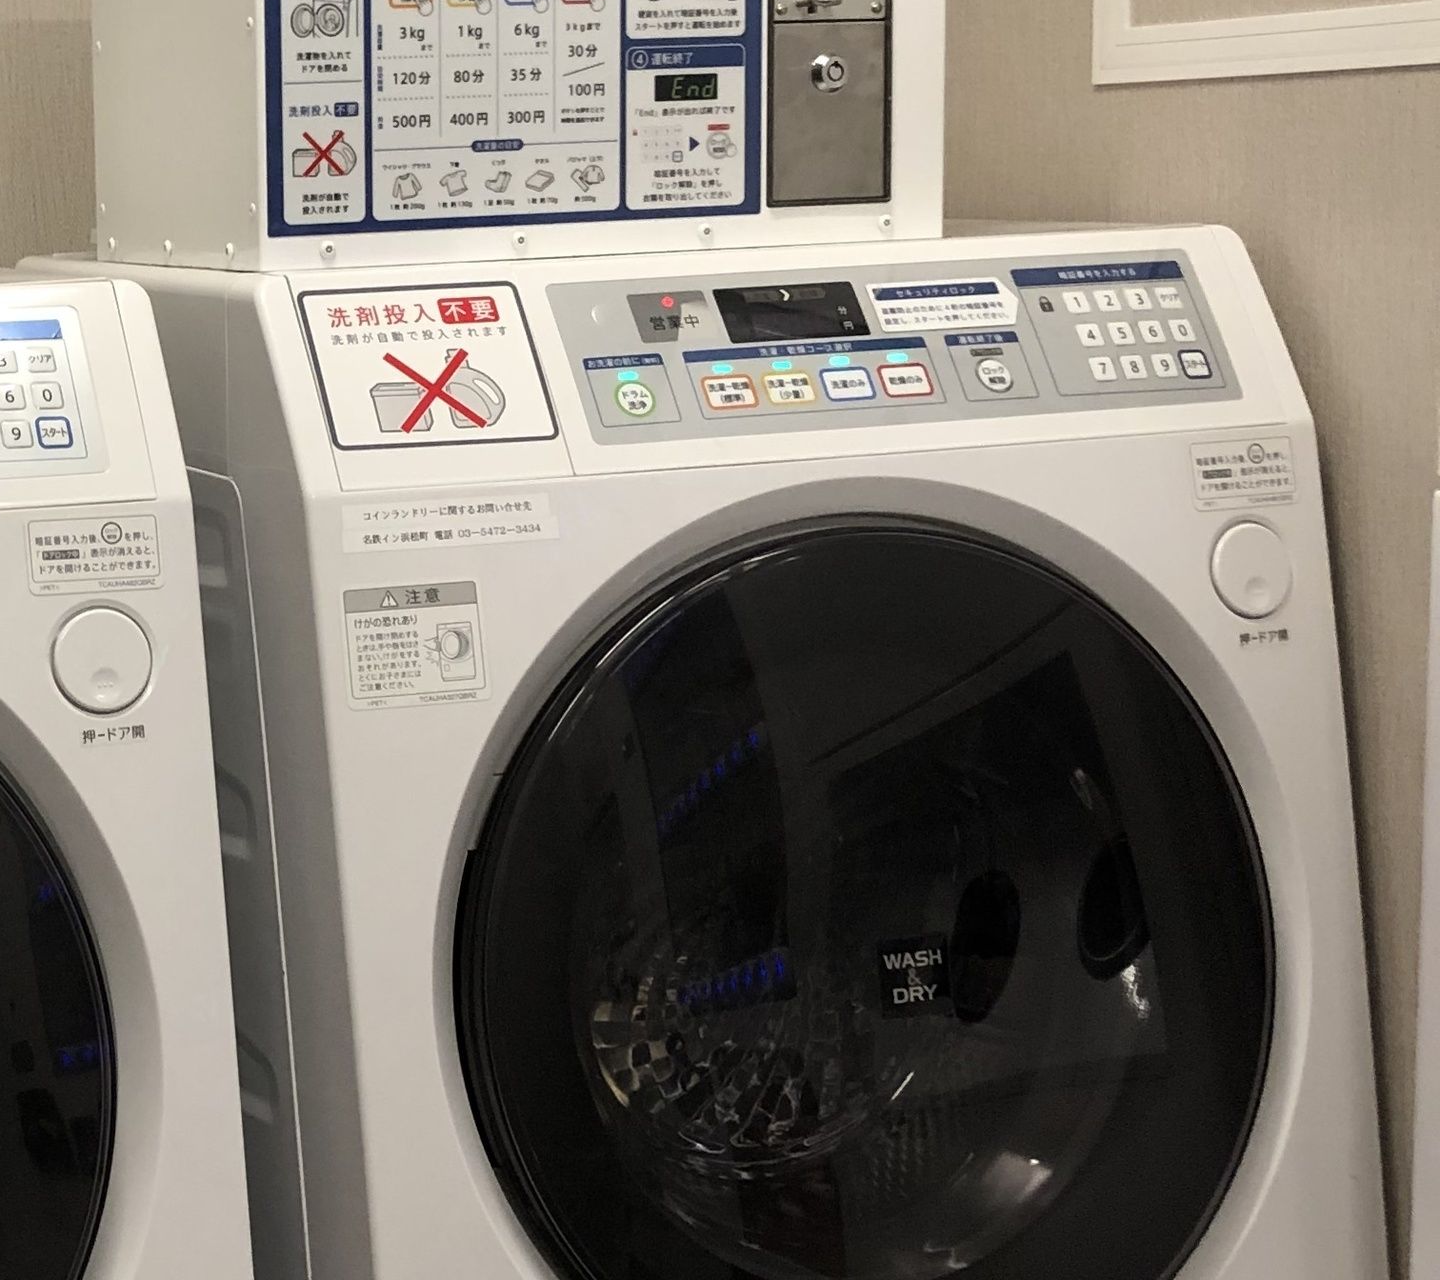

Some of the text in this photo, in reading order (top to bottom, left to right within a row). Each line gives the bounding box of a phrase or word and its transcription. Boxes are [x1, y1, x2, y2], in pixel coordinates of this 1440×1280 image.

[400, 27, 425, 41] 3kg
[458, 25, 482, 39] 1kg
[514, 24, 540, 37] 6kg
[568, 45, 597, 57] 30分
[651, 53, 693, 65] 運転終了
[393, 72, 431, 84] 120分
[454, 70, 484, 83] 80分
[511, 69, 541, 81] 35分
[569, 83, 605, 96] 100円
[672, 77, 715, 99] End
[289, 105, 357, 117] 洗剤投入 不要
[508, 111, 545, 123] 300円
[392, 115, 431, 128] 500円
[450, 112, 489, 126] 400円
[1073, 297, 1082, 308] 1
[1104, 295, 1114, 306] 2
[1135, 293, 1144, 305] 3
[327, 300, 496, 328] 洗剤投入 不要
[649, 314, 700, 331] 営業中
[331, 326, 507, 345] 洗剤が自動で投入されます
[1087, 329, 1096, 341] 4
[1118, 328, 1127, 339] 5
[1149, 326, 1158, 337] 6
[1178, 325, 1187, 336] 0
[982, 366, 1005, 375] ロック
[1099, 363, 1106, 374] 7
[1130, 361, 1139, 373] 8
[1160, 359, 1169, 371] 9
[831, 378, 865, 389] 洗濯のみ
[5, 391, 15, 402] 6
[42, 389, 52, 401] 0
[622, 391, 648, 399] ドラム
[12, 428, 21, 440] 9
[42, 428, 67, 438] スタート
[364, 501, 532, 520] コインランドリーに関するお問い合せ先
[435, 530, 453, 540] 電話
[458, 524, 540, 538] 03-5472-3434
[406, 588, 440, 604] 注意
[354, 615, 417, 628] けがの恐れあり
[883, 949, 942, 969] WASH
[908, 968, 922, 985] &
[893, 984, 937, 1004] DRY
